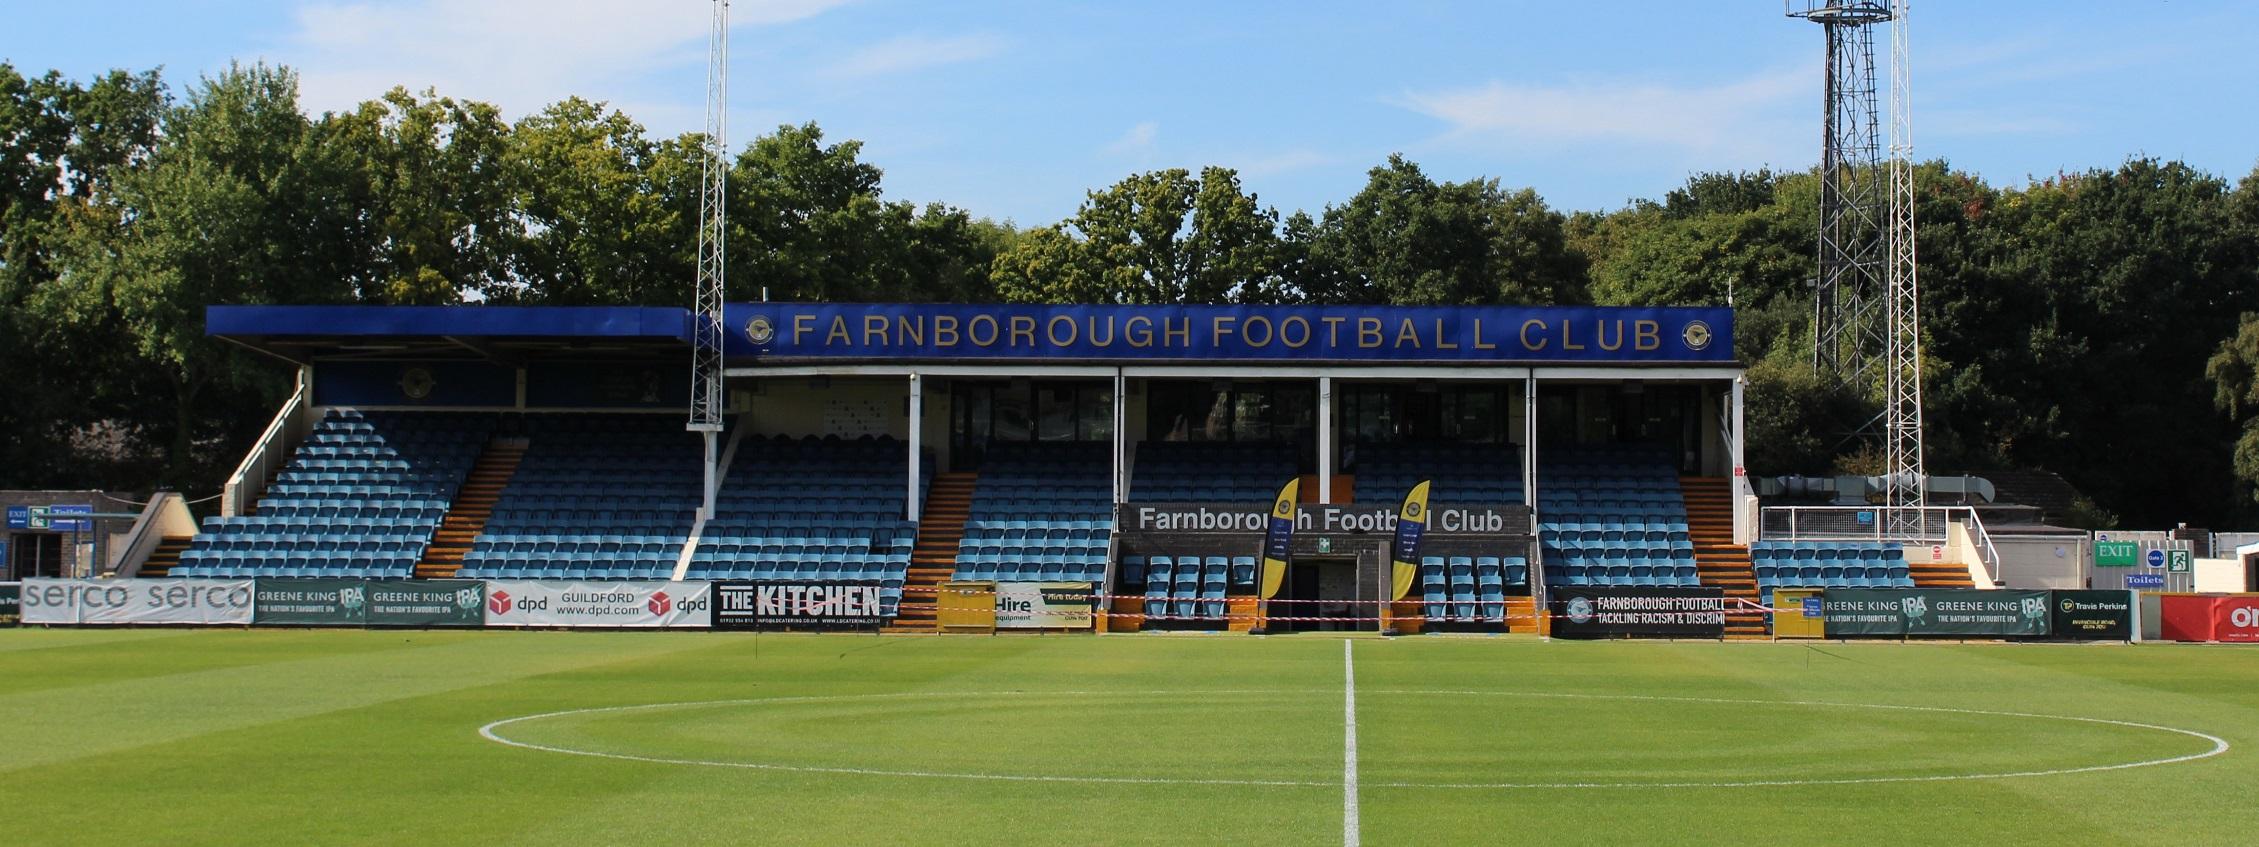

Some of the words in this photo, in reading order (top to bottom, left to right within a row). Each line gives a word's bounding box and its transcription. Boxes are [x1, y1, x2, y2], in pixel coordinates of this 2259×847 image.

[794, 314, 1192, 347] FARNBOROUGH
[1212, 317, 1496, 350] FOOTBALL
[1520, 319, 1661, 351] CLUB
[1139, 508, 1312, 531] Farnboroh
[1325, 508, 1431, 532] Footbl
[1441, 509, 1503, 532] Club
[2099, 546, 2133, 557] EXIT
[25, 584, 128, 607] serco
[148, 584, 251, 608] serco
[257, 592, 304, 602] GREENE
[307, 592, 337, 602] KING
[340, 588, 365, 605] IPA
[373, 592, 420, 602] GREENE
[423, 592, 453, 602] KING
[456, 588, 481, 605] IPA
[562, 593, 635, 603] GUILDFORD
[720, 592, 753, 609] THE
[758, 586, 880, 615] KITCHEN
[518, 596, 547, 613] dpd
[557, 605, 639, 616] www.dpd.com
[678, 597, 706, 614] dpd
[995, 597, 1031, 612] Hire
[1597, 597, 1671, 610] FARNBOROUGH
[1676, 598, 1724, 610] FOOTBALL
[1824, 601, 1863, 611] REENE
[1867, 602, 1898, 611] KING
[1901, 597, 1927, 613] IPA
[1936, 602, 1983, 612] GREENE
[1987, 602, 2017, 612] KING
[2021, 598, 2047, 614] IPA
[2075, 602, 2097, 610] Travis
[2099, 602, 2127, 610] Perkins
[1598, 613, 1638, 624] TACKLING
[1641, 613, 1674, 624] RACISM
[1677, 613, 1684, 624] &
[1830, 615, 1855, 623] NATION'S
[1857, 615, 1887, 623] FAVOURITE
[1888, 615, 1898, 623] IPA
[1938, 615, 1948, 623] THE
[1950, 615, 1974, 623] NATION'S
[1976, 615, 2005, 623] FAVOURITE
[2007, 615, 2017, 623] IPA
